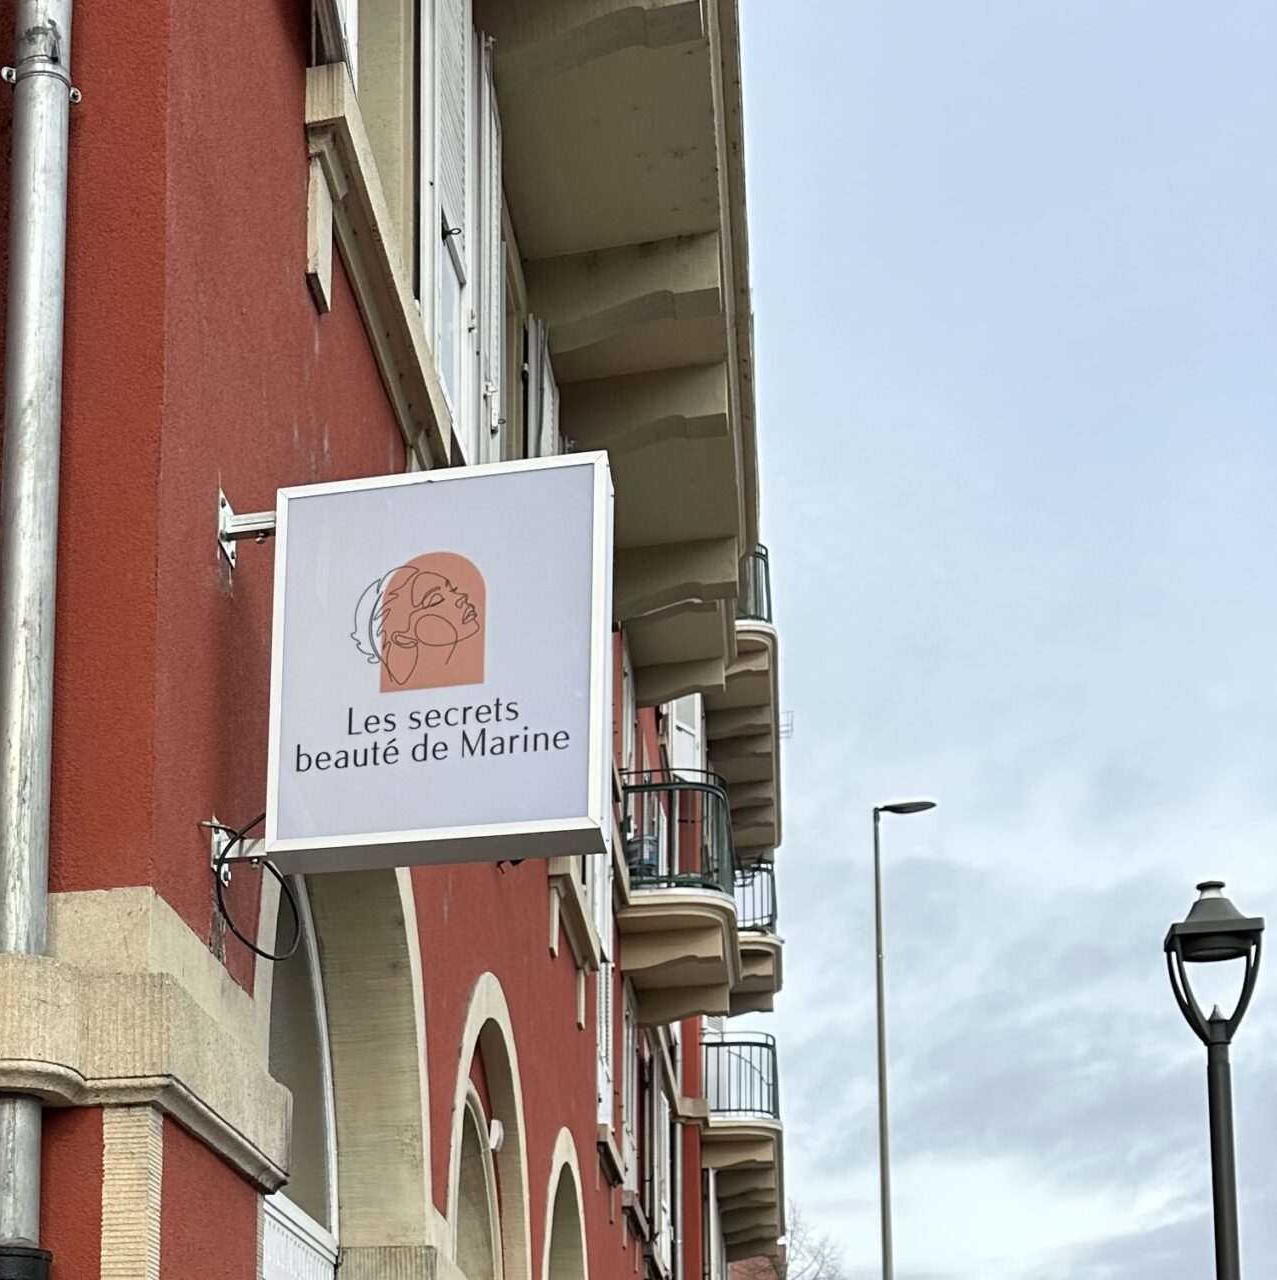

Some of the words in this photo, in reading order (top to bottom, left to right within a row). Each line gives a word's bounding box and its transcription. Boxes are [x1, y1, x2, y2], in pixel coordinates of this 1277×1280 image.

[347, 707, 396, 735] Les
[408, 697, 519, 730] secrets
[296, 738, 399, 772] beauté
[411, 732, 448, 762] de
[461, 726, 570, 758] Marine
